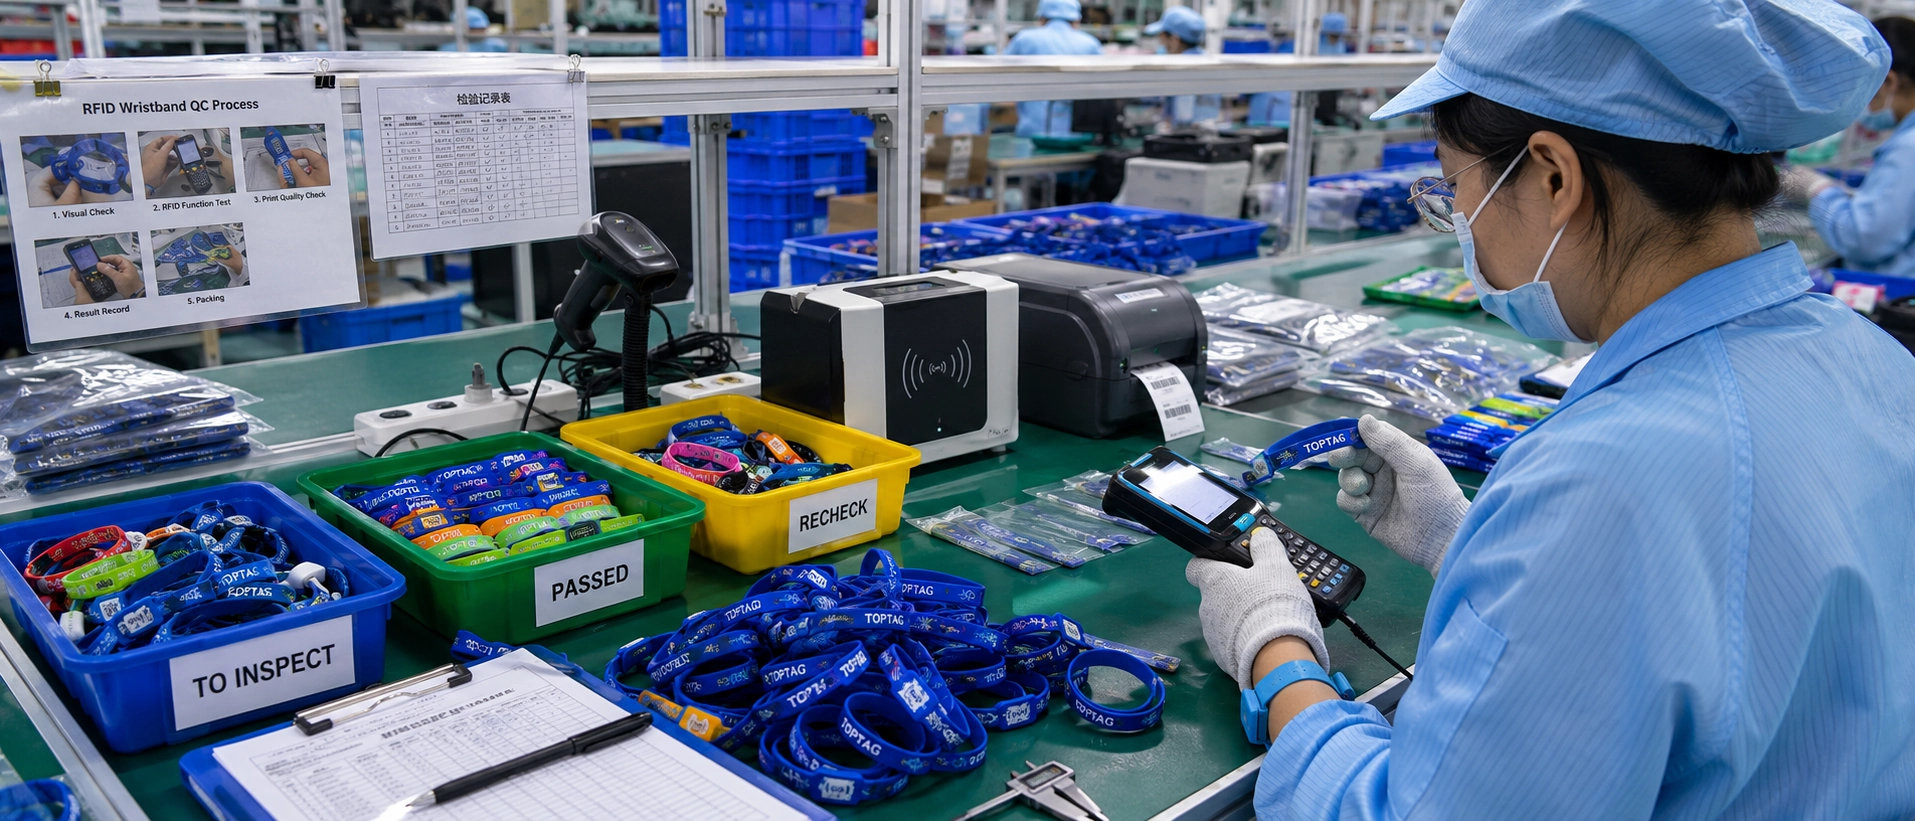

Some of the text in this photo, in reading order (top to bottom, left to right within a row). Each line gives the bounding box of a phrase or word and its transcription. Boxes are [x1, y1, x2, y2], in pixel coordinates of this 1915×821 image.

[82, 100, 259, 115] RFID Wristband QC Process
[280, 192, 304, 201] Quality
[305, 190, 326, 199] Check
[162, 202, 180, 210] RFID
[181, 200, 214, 209] Function
[53, 207, 115, 219] 1. Visual Check
[187, 294, 225, 305] 5. Packing
[64, 304, 130, 319] 4. Result Record
[799, 498, 868, 532] RECHECK
[552, 564, 629, 602] PASSED
[864, 613, 904, 625] TOPTAG
[192, 643, 335, 698] TO INSPECT
[841, 717, 882, 756] TOPTAG
